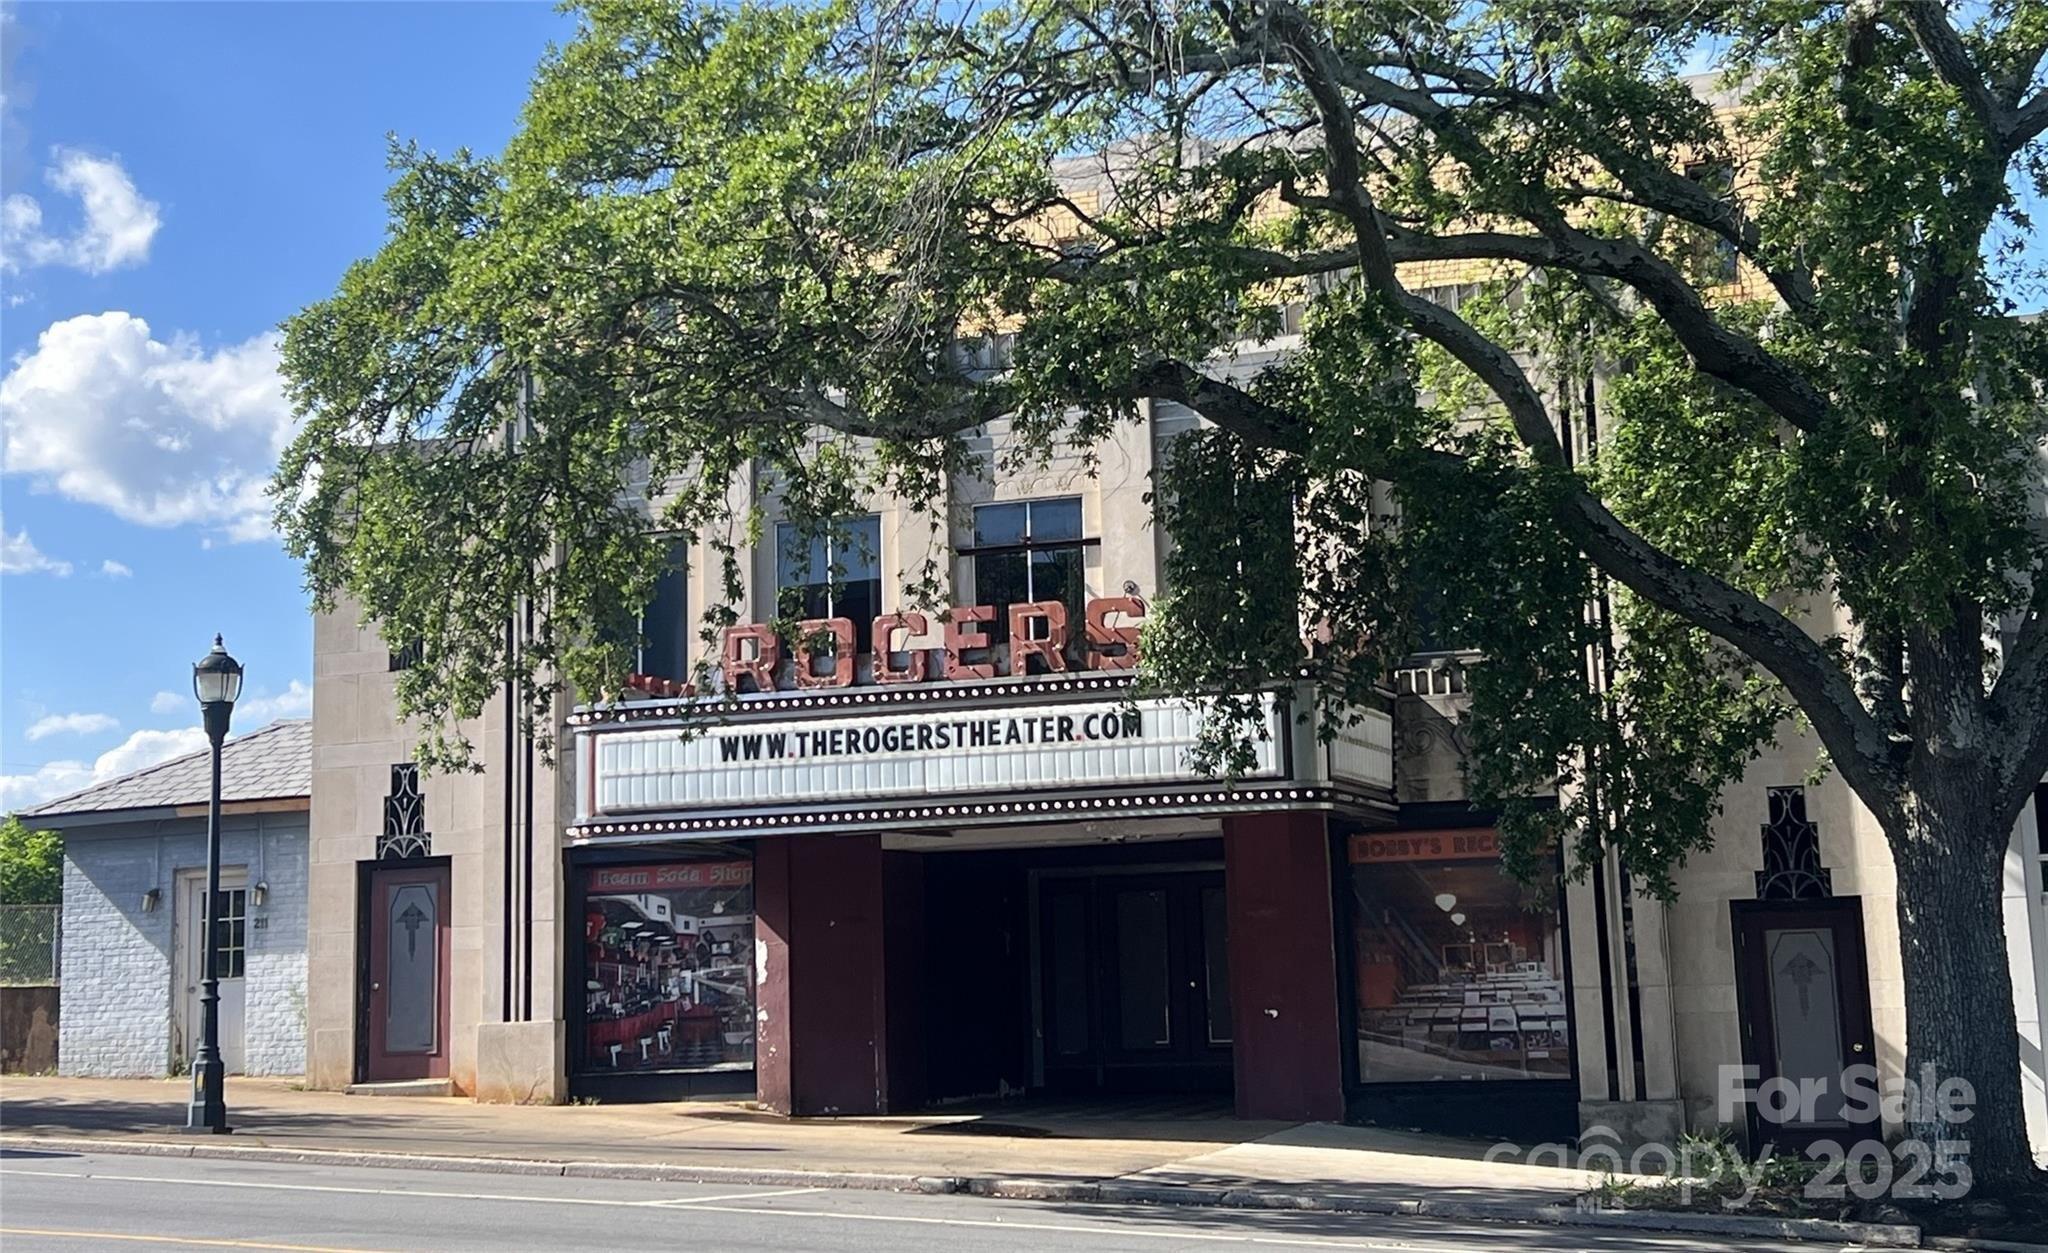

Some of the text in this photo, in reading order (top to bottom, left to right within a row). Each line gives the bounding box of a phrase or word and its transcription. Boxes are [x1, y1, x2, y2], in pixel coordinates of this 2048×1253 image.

[722, 598, 1146, 691] ROGERS
[719, 710, 1143, 762] WWW.THEROGERSTHEATER.COM
[1358, 839, 1442, 859] BOBBY'S
[656, 867, 700, 884] Soda
[254, 917, 268, 929] 211
